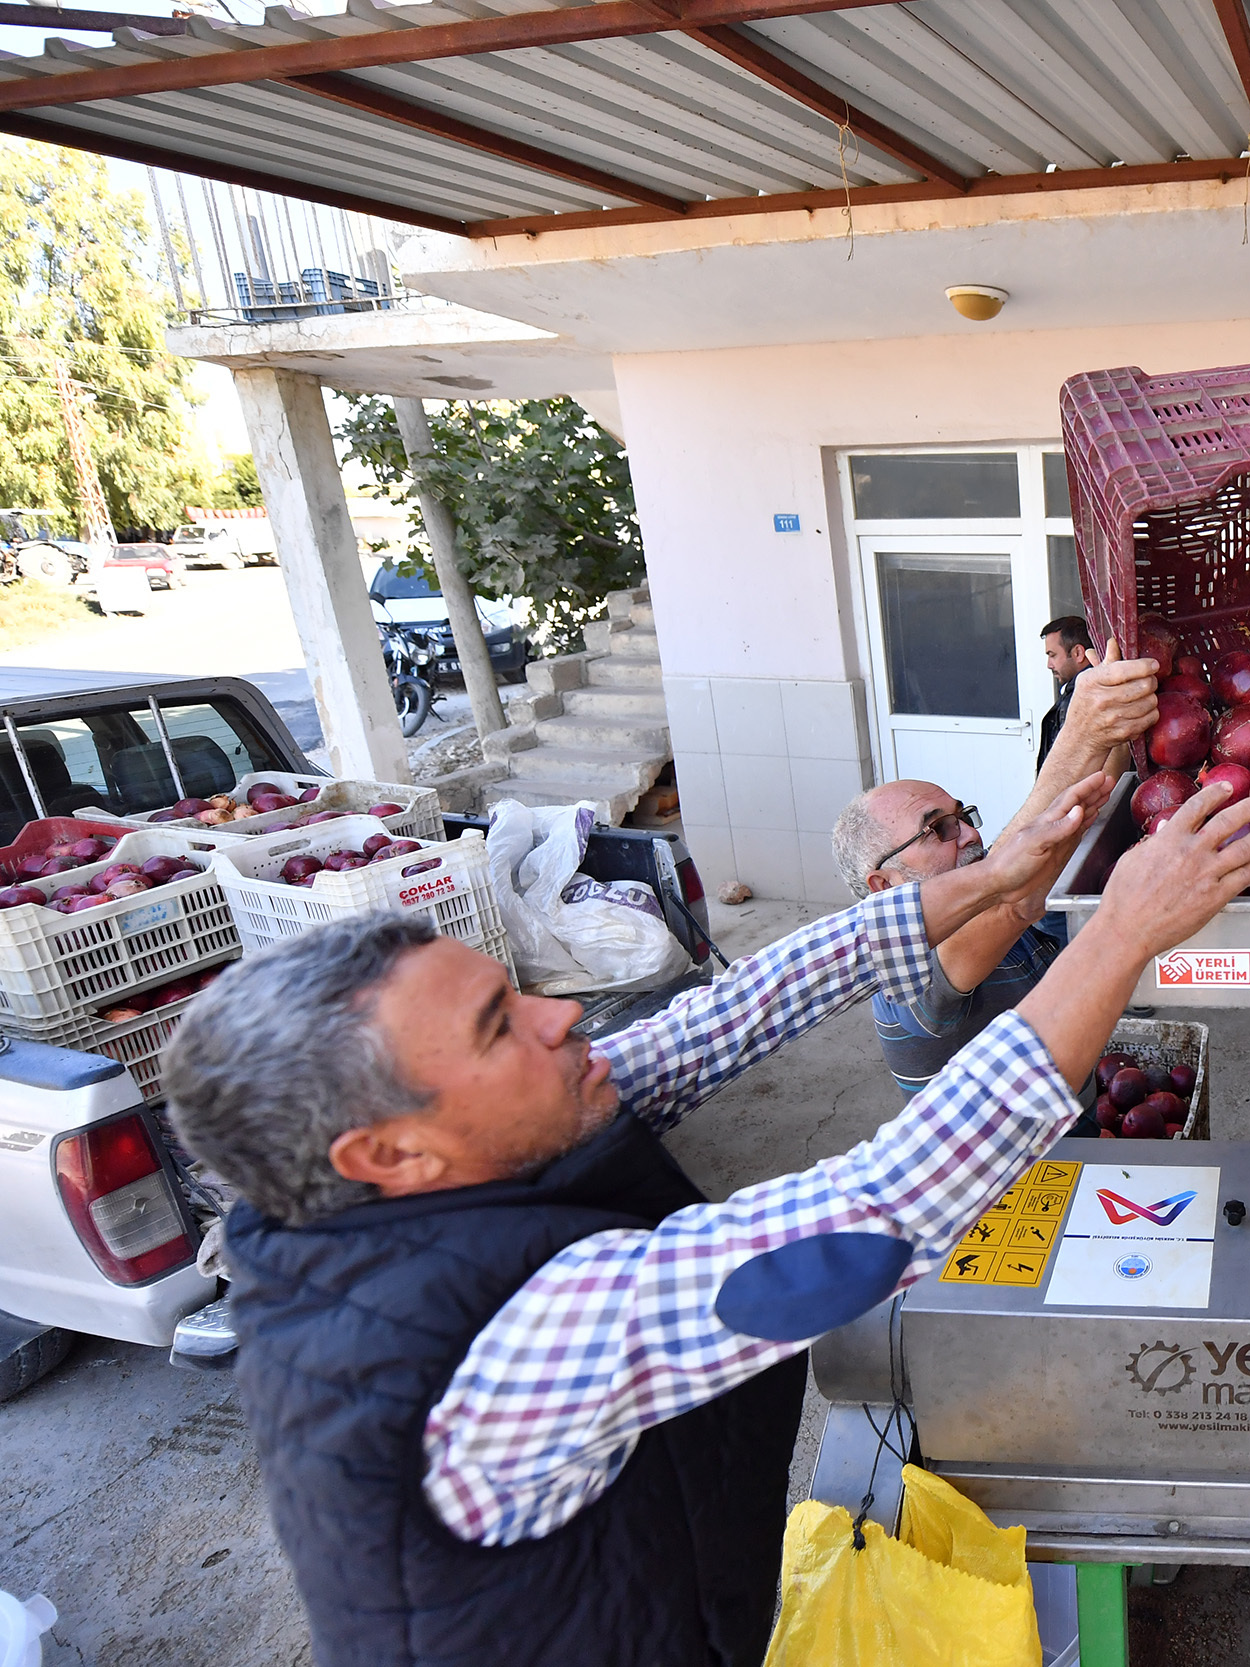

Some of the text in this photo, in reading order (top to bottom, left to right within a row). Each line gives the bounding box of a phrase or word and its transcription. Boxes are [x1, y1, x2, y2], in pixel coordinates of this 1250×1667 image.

[779, 519, 793, 529] 111
[1195, 955, 1235, 968] YERLİ
[1195, 968, 1247, 981] ÜRETİM
[1128, 1409, 1149, 1419] Tel:
[1153, 1410, 1162, 1419] 0
[1165, 1410, 1188, 1420] 338
[1192, 1411, 1212, 1420] 213
[1215, 1412, 1231, 1421] 24
[1234, 1412, 1248, 1421] 18
